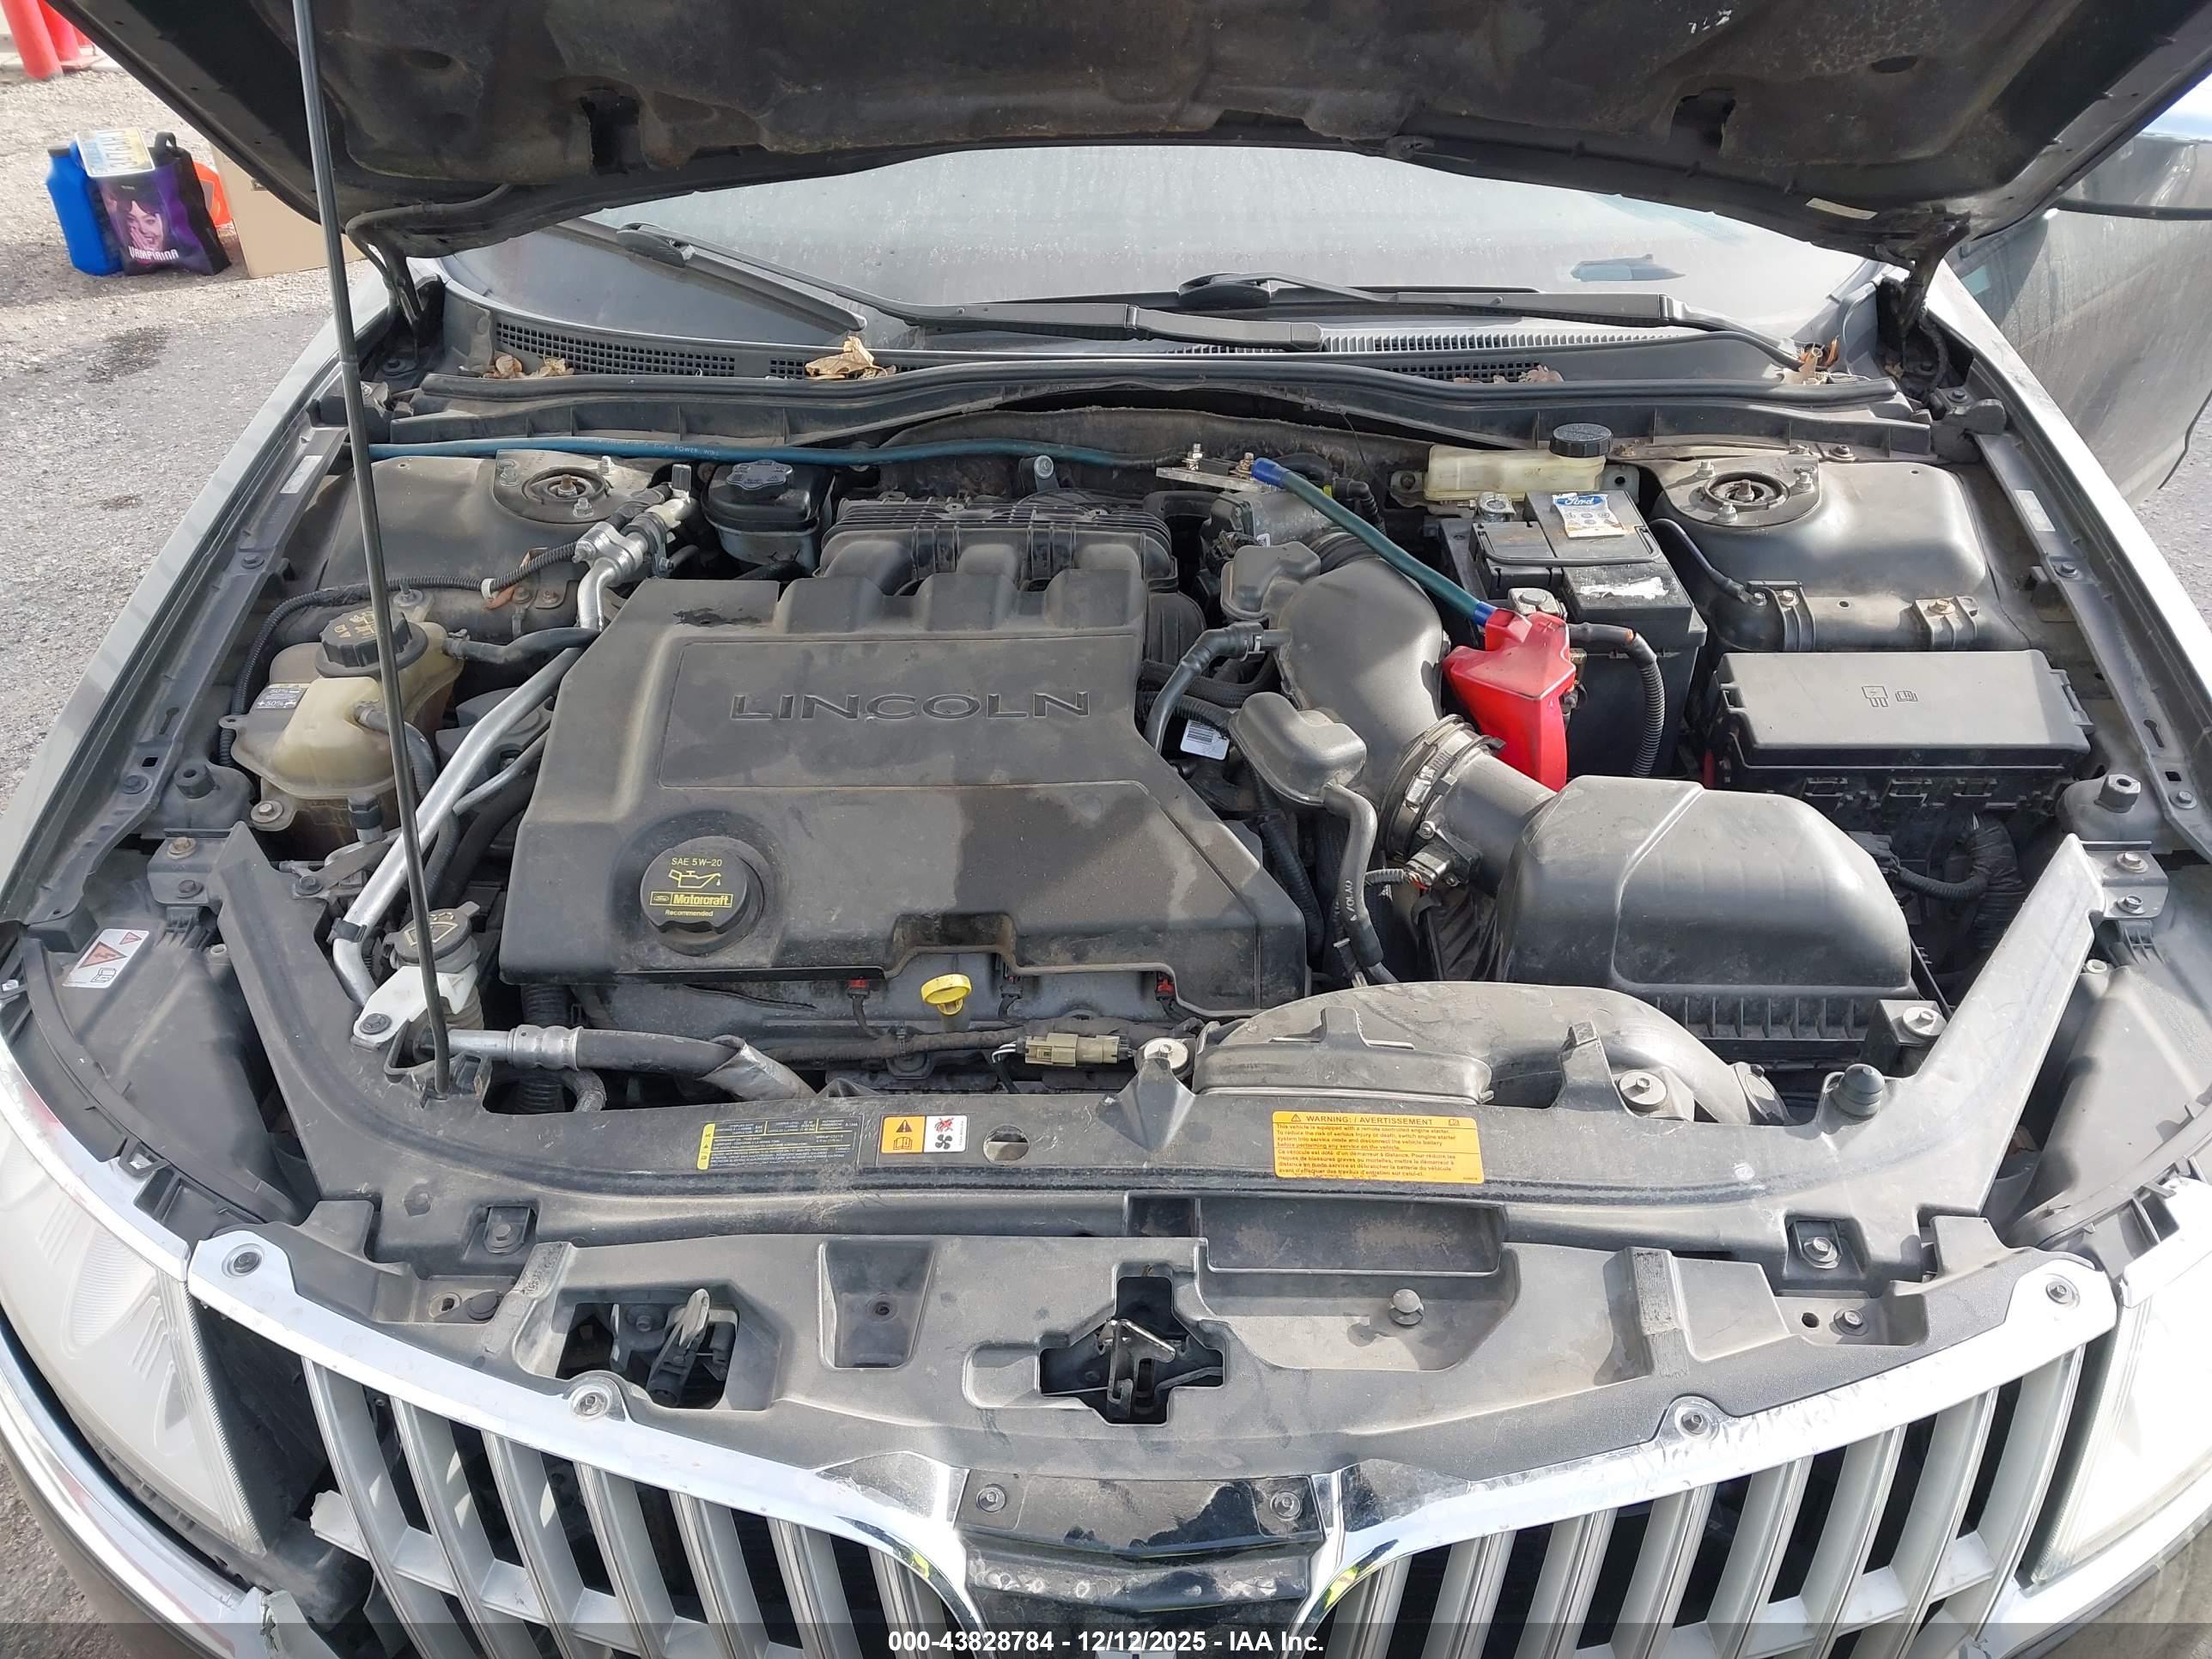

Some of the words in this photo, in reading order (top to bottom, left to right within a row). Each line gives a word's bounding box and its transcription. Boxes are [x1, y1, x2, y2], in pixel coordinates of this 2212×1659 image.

[1565, 496, 1595, 506] Ford
[730, 690, 1090, 720] LINCOLN
[672, 857, 690, 866] SAE
[691, 858, 723, 866] 5W-20
[673, 894, 731, 906] Motorcraft
[1359, 1117, 1433, 1126] AVERTISSEMENT
